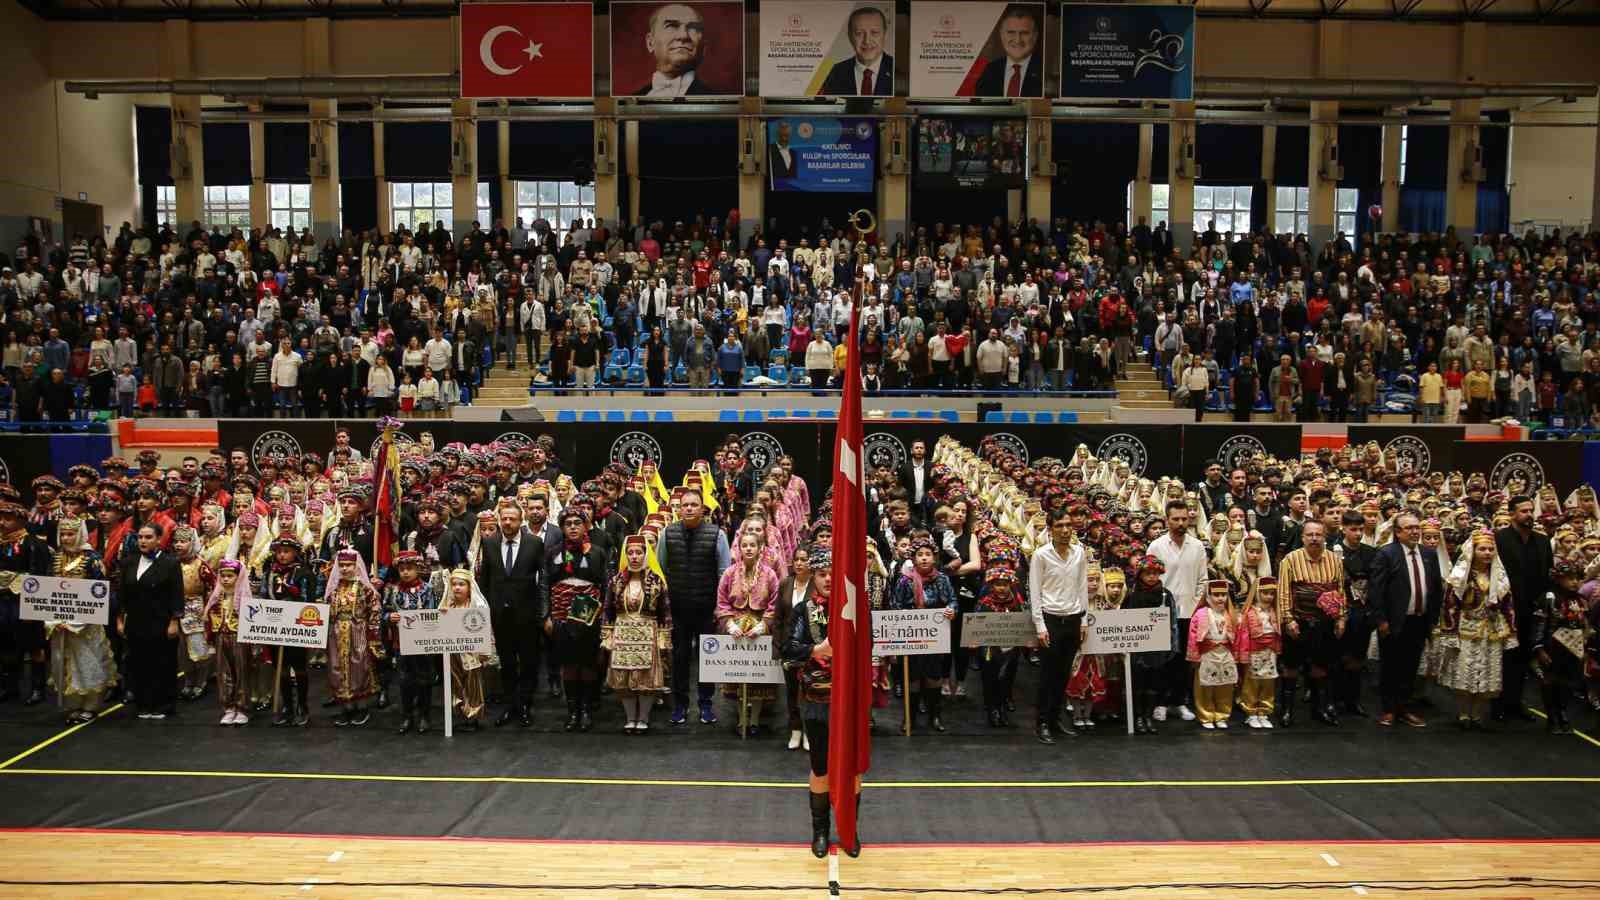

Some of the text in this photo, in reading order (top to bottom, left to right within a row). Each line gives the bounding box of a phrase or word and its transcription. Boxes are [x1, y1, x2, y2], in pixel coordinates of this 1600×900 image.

[75, 600, 104, 608] SANAT
[265, 606, 284, 614] THOF
[420, 612, 440, 621] THOF
[881, 614, 929, 622] KUŞADASI
[249, 625, 318, 637] AYDIN AYDANS
[1125, 624, 1154, 633] SANAT
[725, 643, 768, 651] ABALIM
